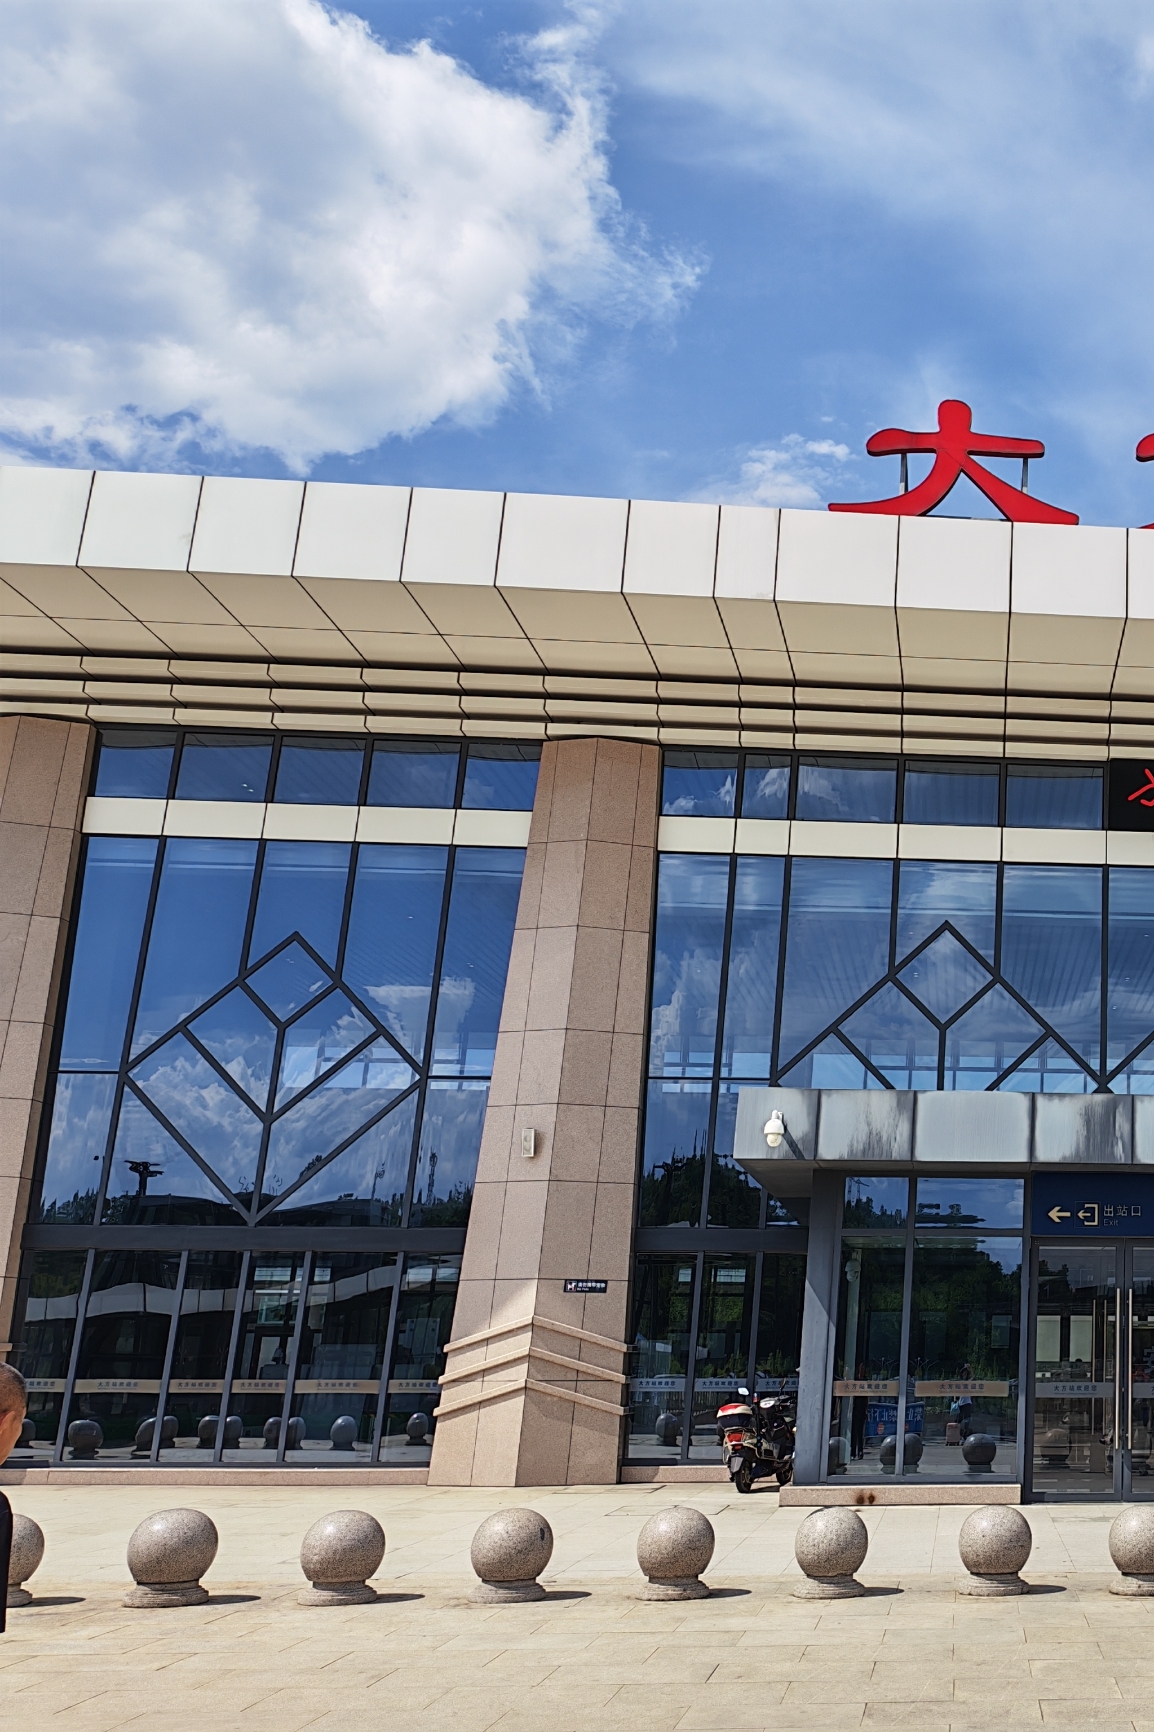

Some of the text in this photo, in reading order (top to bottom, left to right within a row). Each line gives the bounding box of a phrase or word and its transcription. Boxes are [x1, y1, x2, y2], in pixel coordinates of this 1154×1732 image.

[1103, 1204, 1141, 1217] 出站口
[1103, 1218, 1119, 1226] Exit
